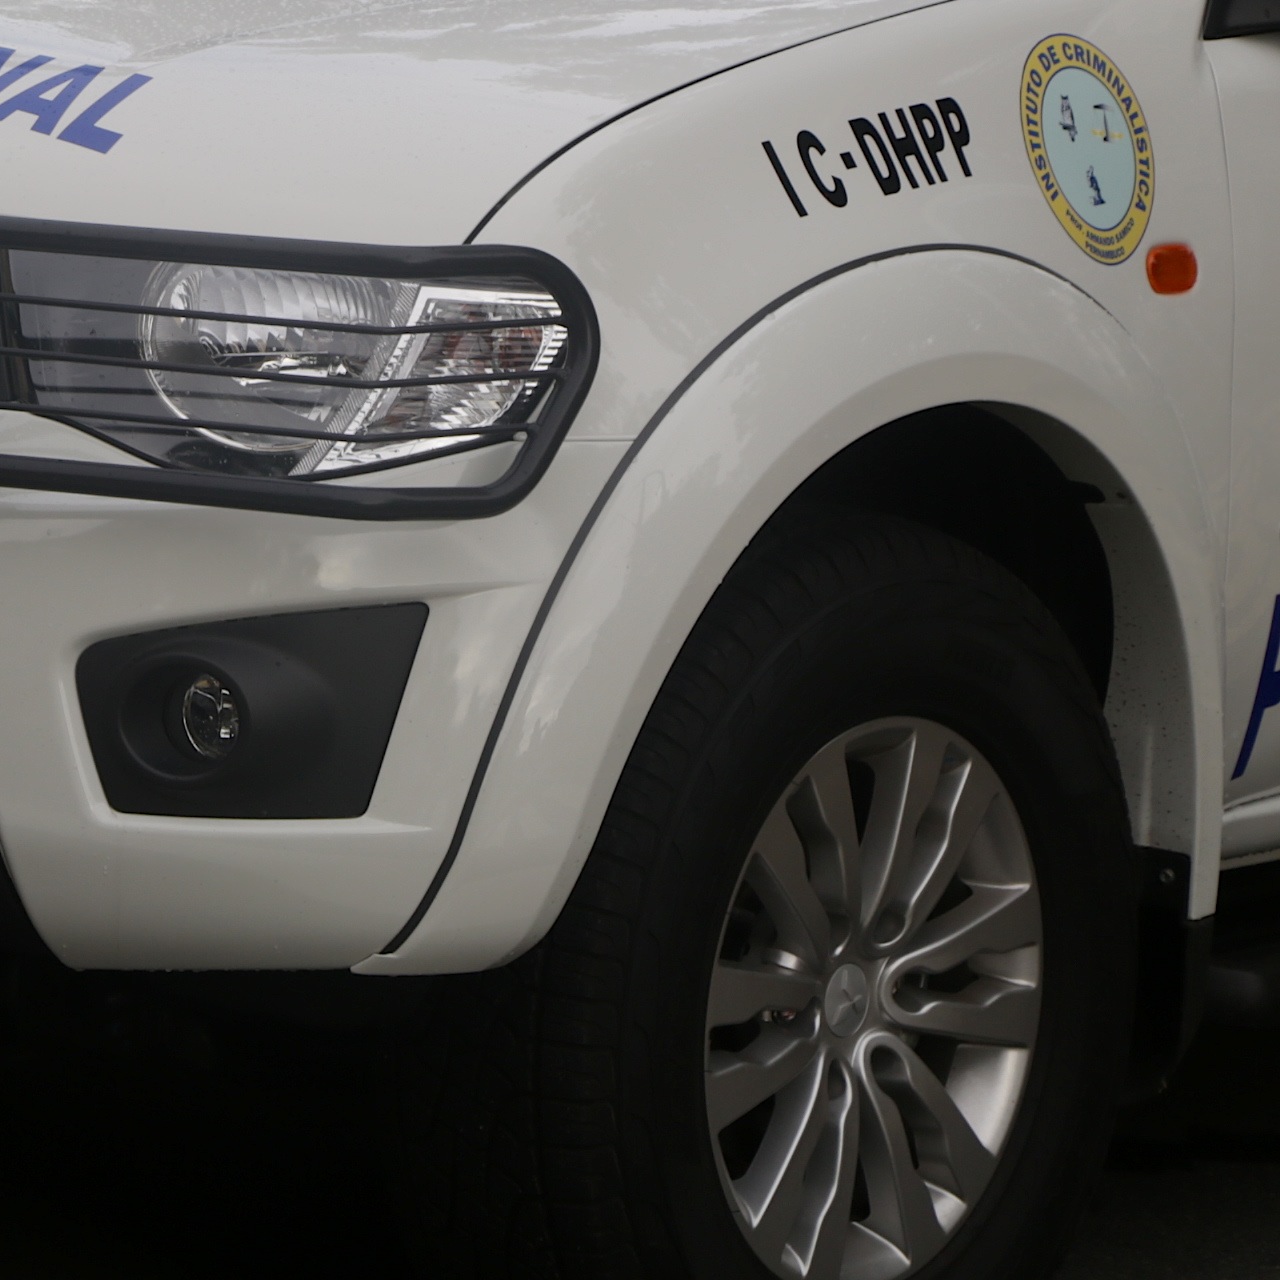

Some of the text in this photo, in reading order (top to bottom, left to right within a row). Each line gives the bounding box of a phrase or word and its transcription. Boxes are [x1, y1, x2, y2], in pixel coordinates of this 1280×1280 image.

[1026, 42, 1150, 212] INSTITUTO DE CRIMINALÍSTICA
